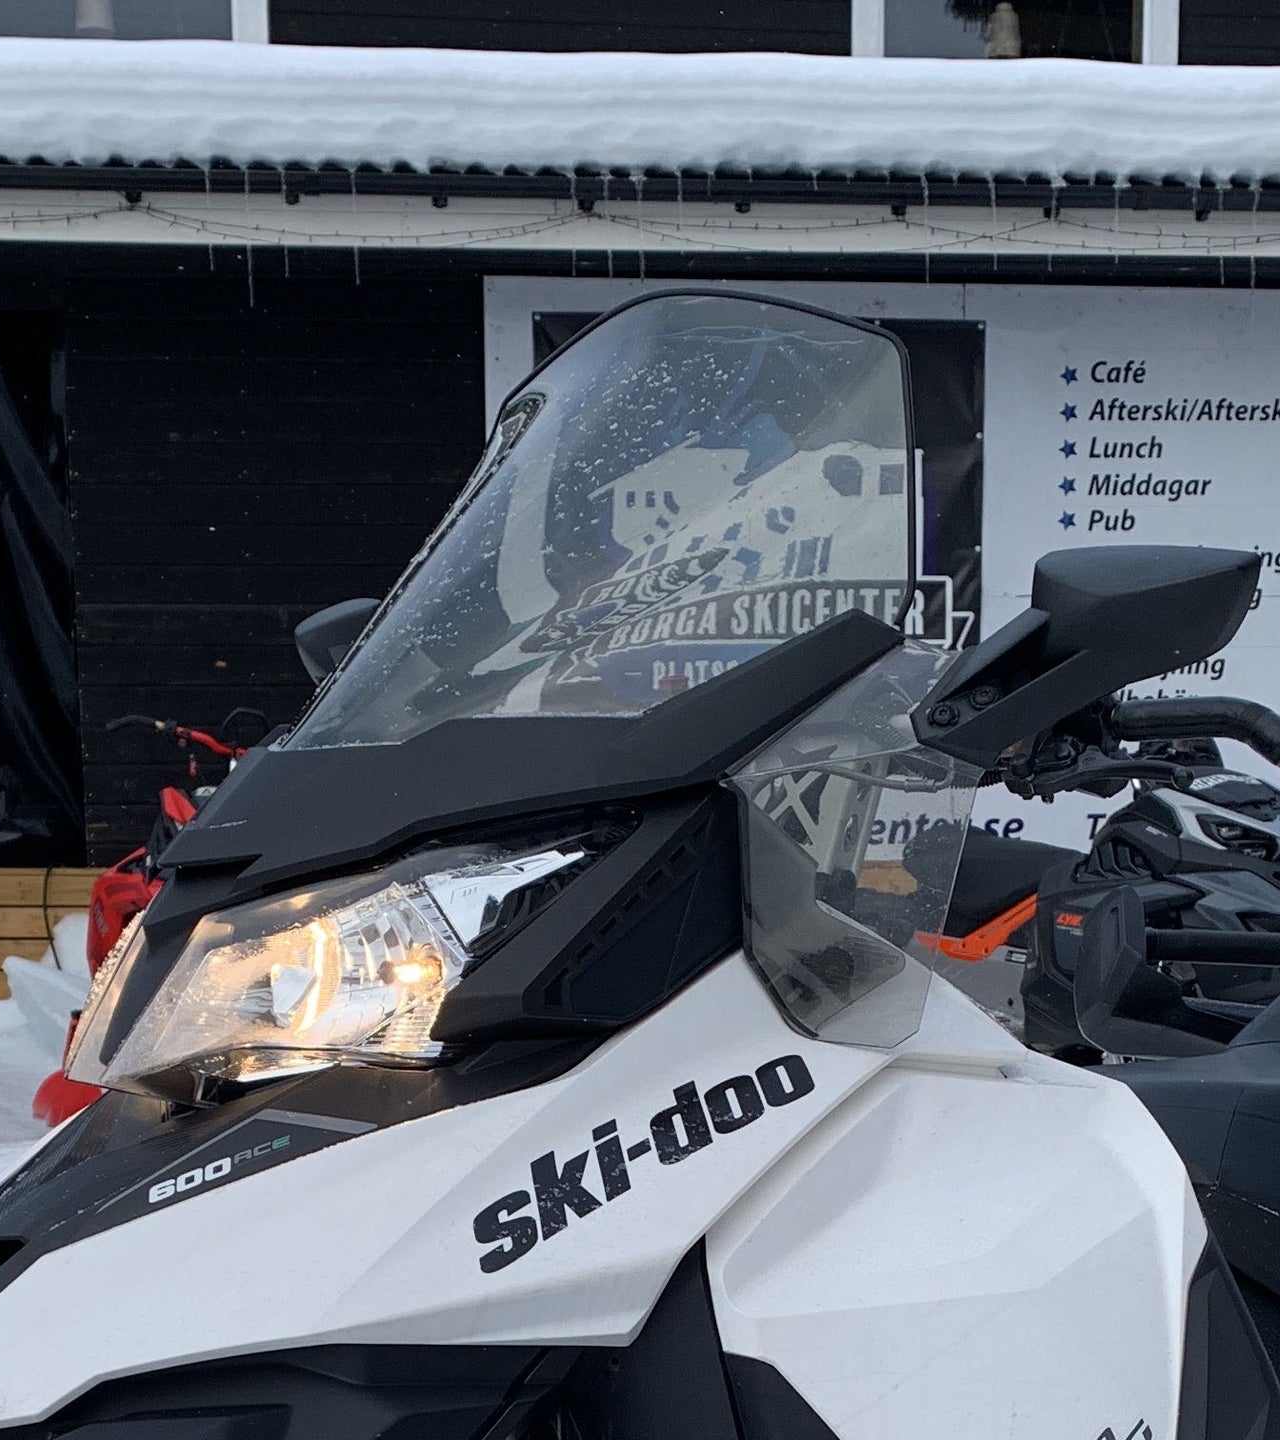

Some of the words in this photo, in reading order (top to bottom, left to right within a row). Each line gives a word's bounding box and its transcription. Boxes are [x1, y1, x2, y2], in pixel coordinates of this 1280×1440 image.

[1089, 360, 1147, 384] Café
[1088, 435, 1163, 459] Lunch
[1087, 473, 1212, 501] Middagar
[1087, 508, 1136, 531] Pub
[148, 1157, 232, 1203] 600
[233, 1135, 291, 1164] ACE
[473, 1053, 815, 1274] ski-doo
